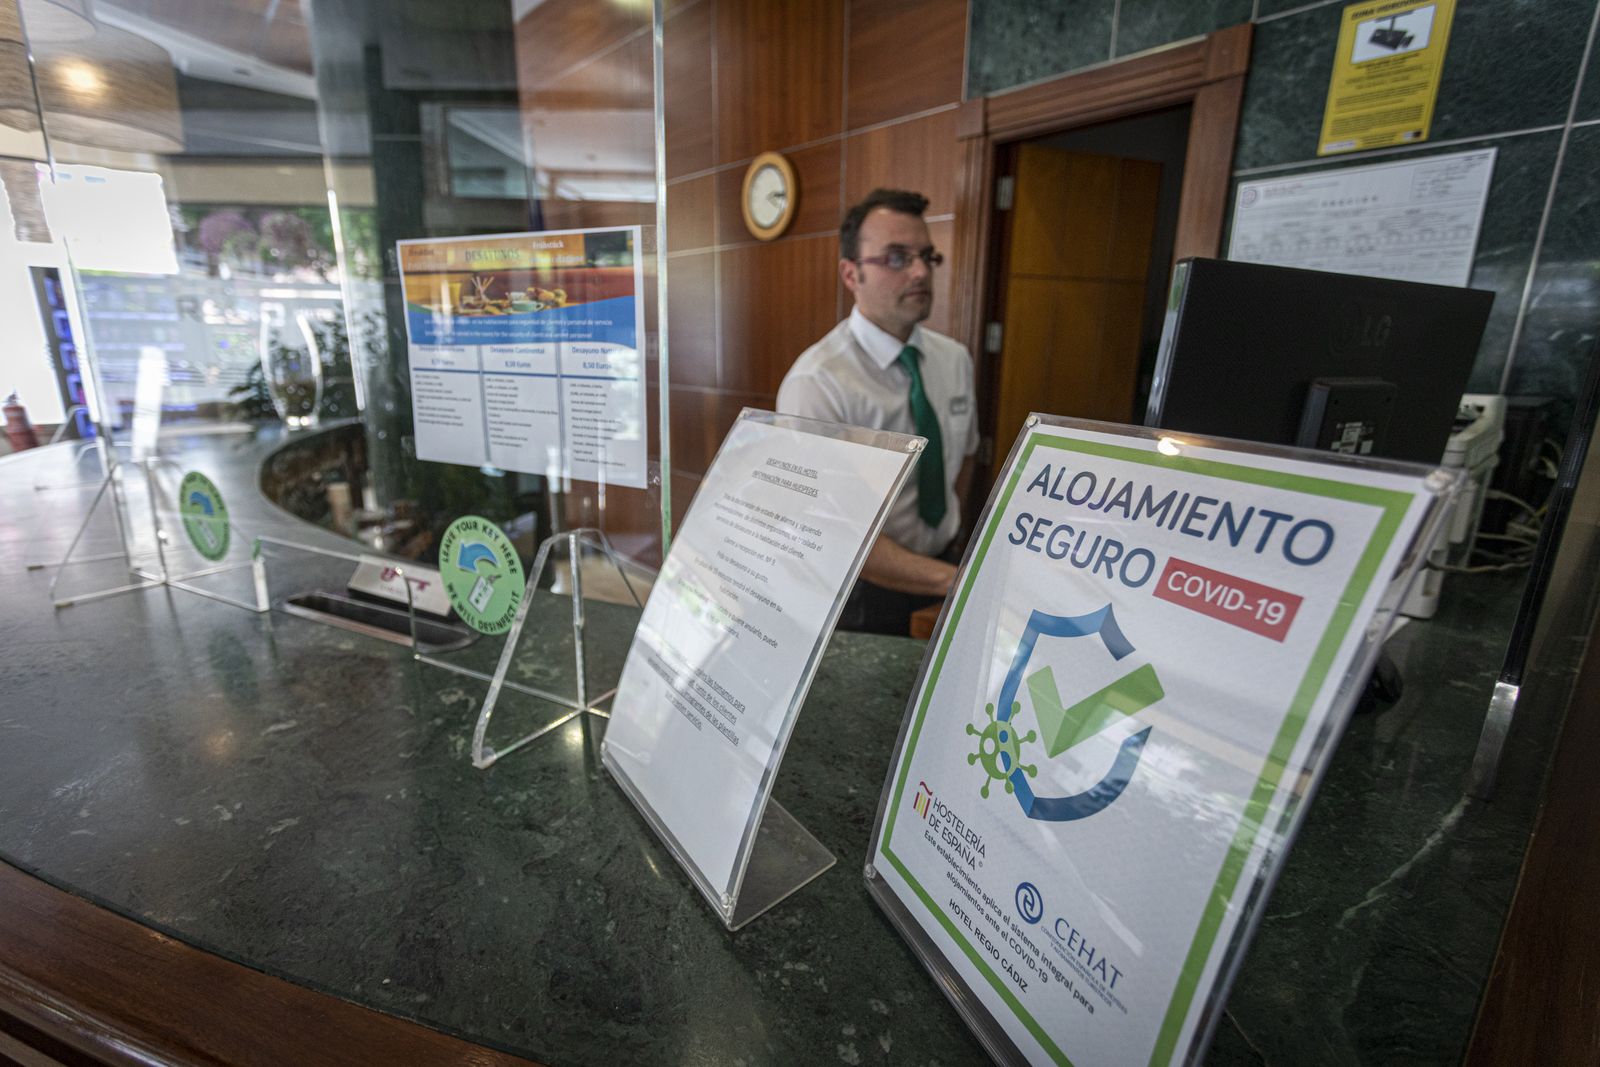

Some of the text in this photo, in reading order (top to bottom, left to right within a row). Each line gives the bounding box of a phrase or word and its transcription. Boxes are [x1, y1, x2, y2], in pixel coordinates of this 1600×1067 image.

[465, 249, 521, 262] DESAYUNOS
[571, 346, 600, 356] Desayuno
[803, 467, 818, 478] HOTEL
[1026, 464, 1335, 566] ALOJAMIENTO
[441, 520, 517, 575] LEAVE YOUR KEY HERE
[1008, 512, 1288, 626] SEGURO COVID-19
[447, 582, 458, 600] WE
[456, 600, 476, 627] WILL
[510, 590, 519, 605] IT
[763, 633, 778, 648] puede
[706, 693, 712, 703] de
[719, 703, 737, 724] clientes
[706, 709, 711, 720] de
[734, 698, 745, 712] para
[929, 813, 975, 870] DE ESPAÑA
[933, 798, 985, 858] HOSTELERÍA
[924, 830, 1095, 1015] Este establecimiento aplica el sistema integral para
[946, 871, 1049, 984] alojamientos ante el COVID-19
[949, 899, 1028, 993] HOTEL REGIO CÁDIZ
[1055, 918, 1124, 989] CEHAT
